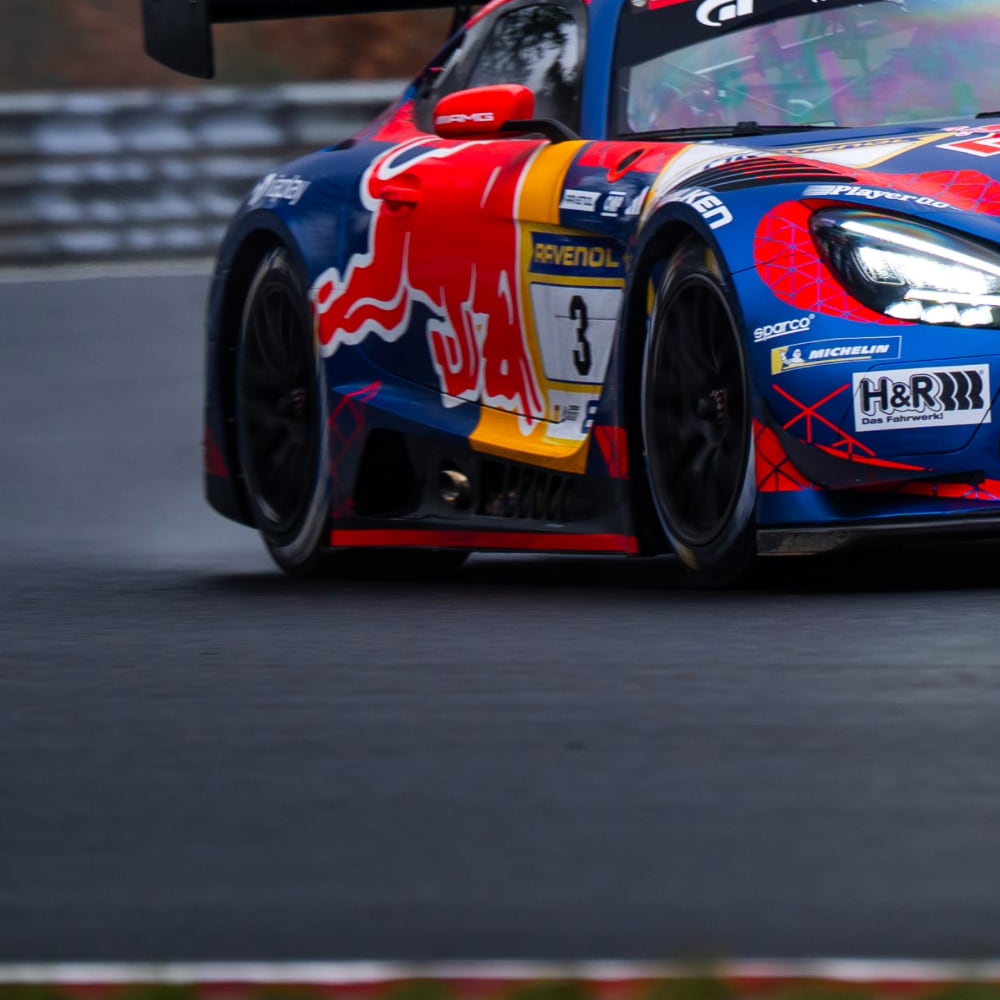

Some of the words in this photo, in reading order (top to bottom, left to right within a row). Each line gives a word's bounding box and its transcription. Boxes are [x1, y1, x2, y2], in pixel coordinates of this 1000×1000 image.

[449, 112, 495, 123] AMG
[827, 184, 918, 201] Player
[569, 295, 592, 376] 3
[754, 316, 811, 340] sparco
[808, 344, 890, 360] MICHELIN
[860, 373, 940, 416] H&R
[862, 416, 884, 426] Das
[886, 412, 944, 425] Fahrwerk!
